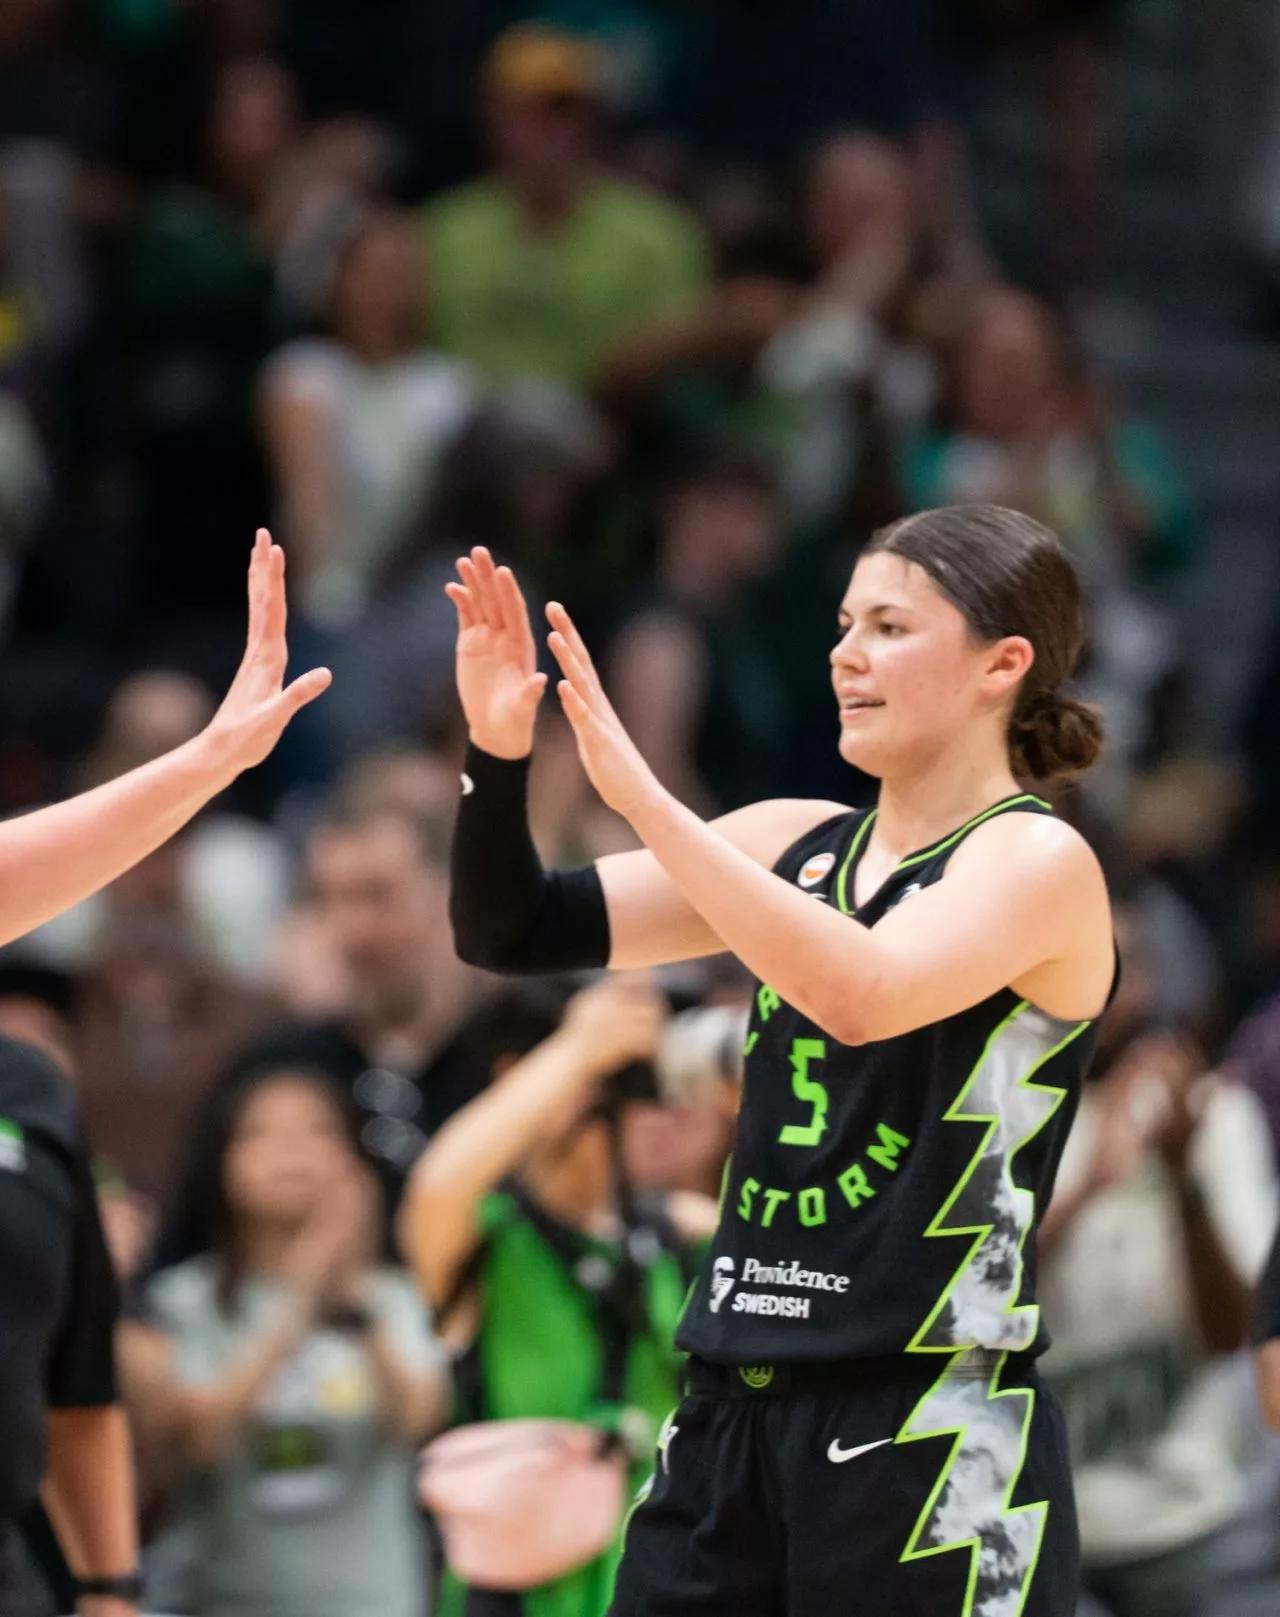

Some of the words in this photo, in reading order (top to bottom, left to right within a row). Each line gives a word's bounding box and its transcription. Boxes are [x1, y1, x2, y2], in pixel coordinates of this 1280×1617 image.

[777, 1036, 829, 1147] 5
[737, 1121, 911, 1229] STORM
[731, 1291, 812, 1319] SWEDISH
[739, 1257, 851, 1294] Providence
